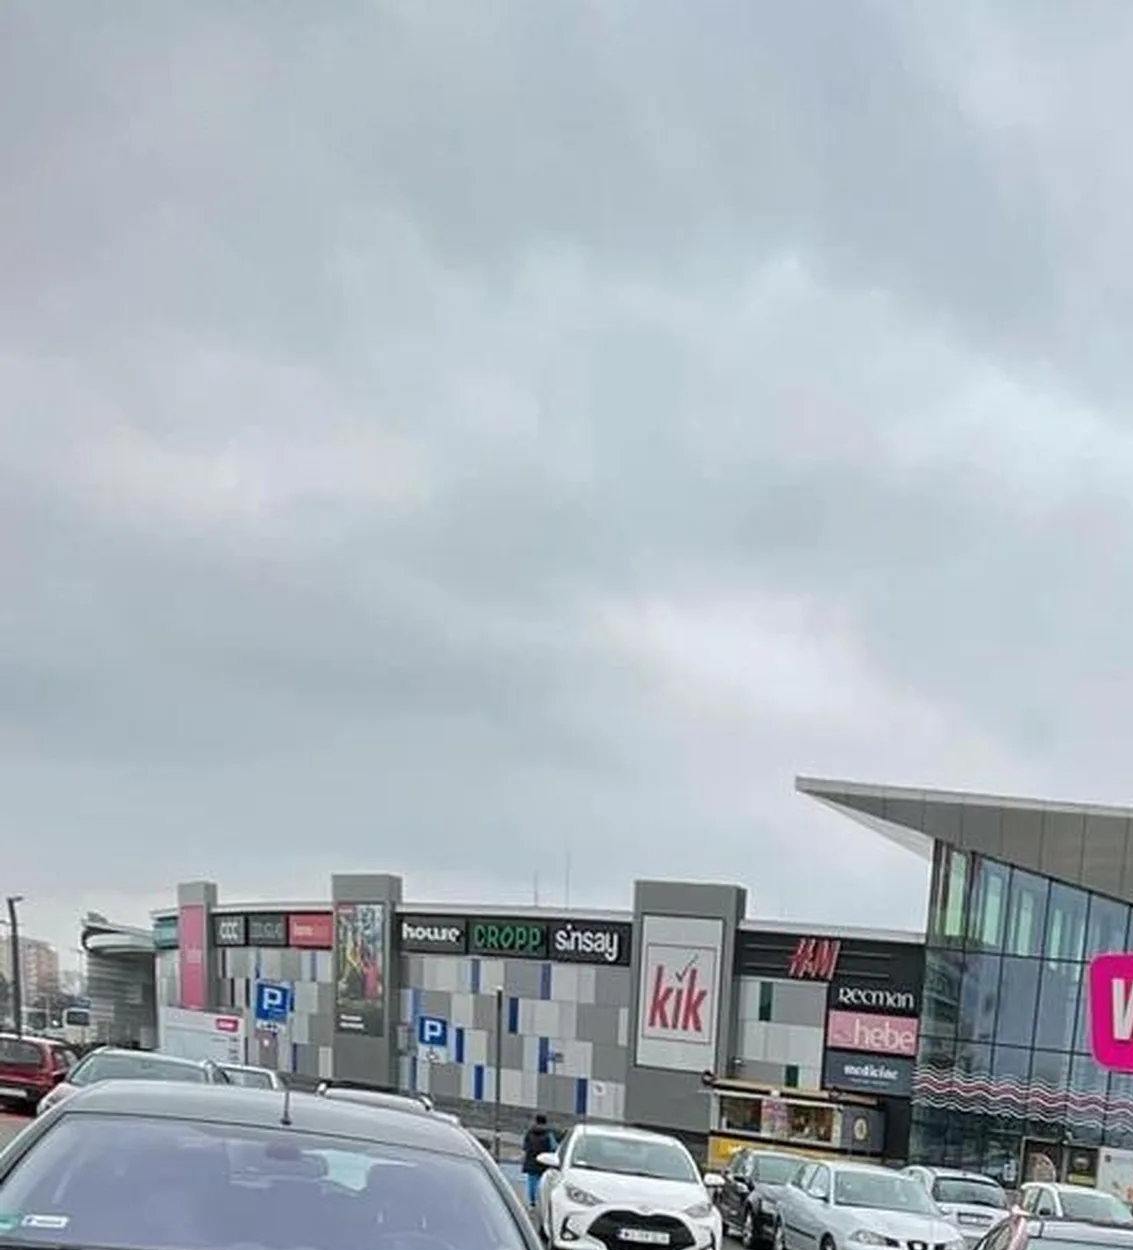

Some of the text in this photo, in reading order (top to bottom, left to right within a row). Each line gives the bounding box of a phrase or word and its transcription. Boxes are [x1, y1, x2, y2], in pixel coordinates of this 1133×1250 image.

[472, 924, 542, 949] CROPP
[555, 924, 620, 962] sinsay
[263, 987, 282, 1010] P
[424, 1019, 443, 1041] P
[853, 1017, 914, 1051] hebe
